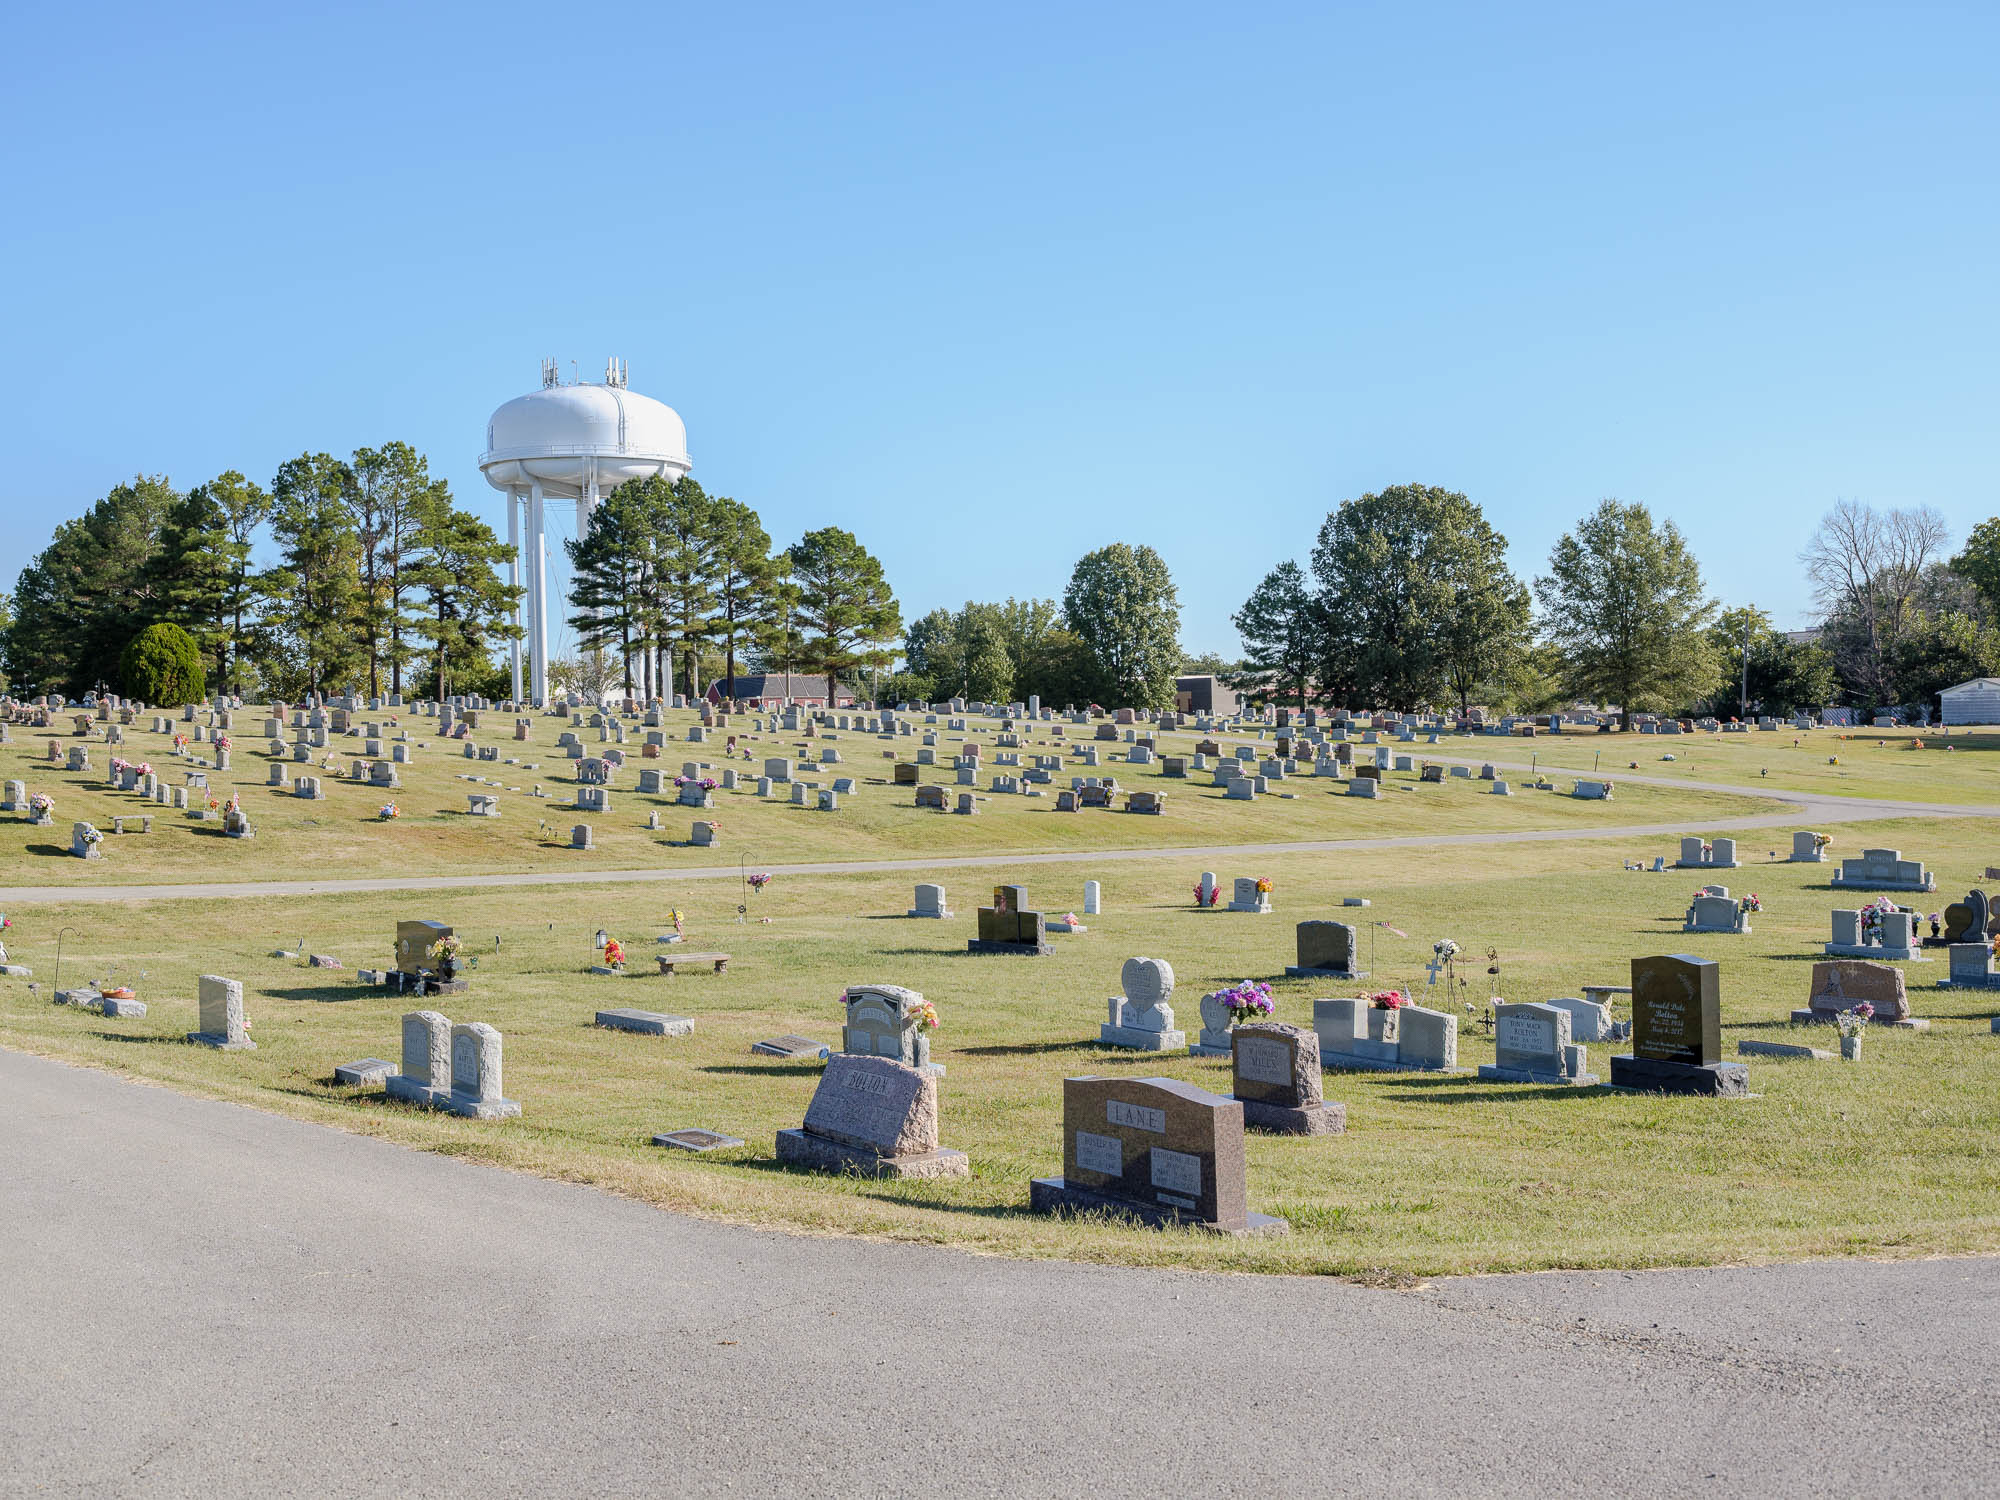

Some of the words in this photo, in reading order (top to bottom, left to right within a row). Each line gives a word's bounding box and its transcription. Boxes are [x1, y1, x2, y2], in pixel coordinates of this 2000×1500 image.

[1655, 1010, 1678, 1019] Bolton
[1514, 1028, 1538, 1038] BOLTON
[848, 1071, 888, 1093] BOLTON
[1115, 1104, 1157, 1129] LANE
